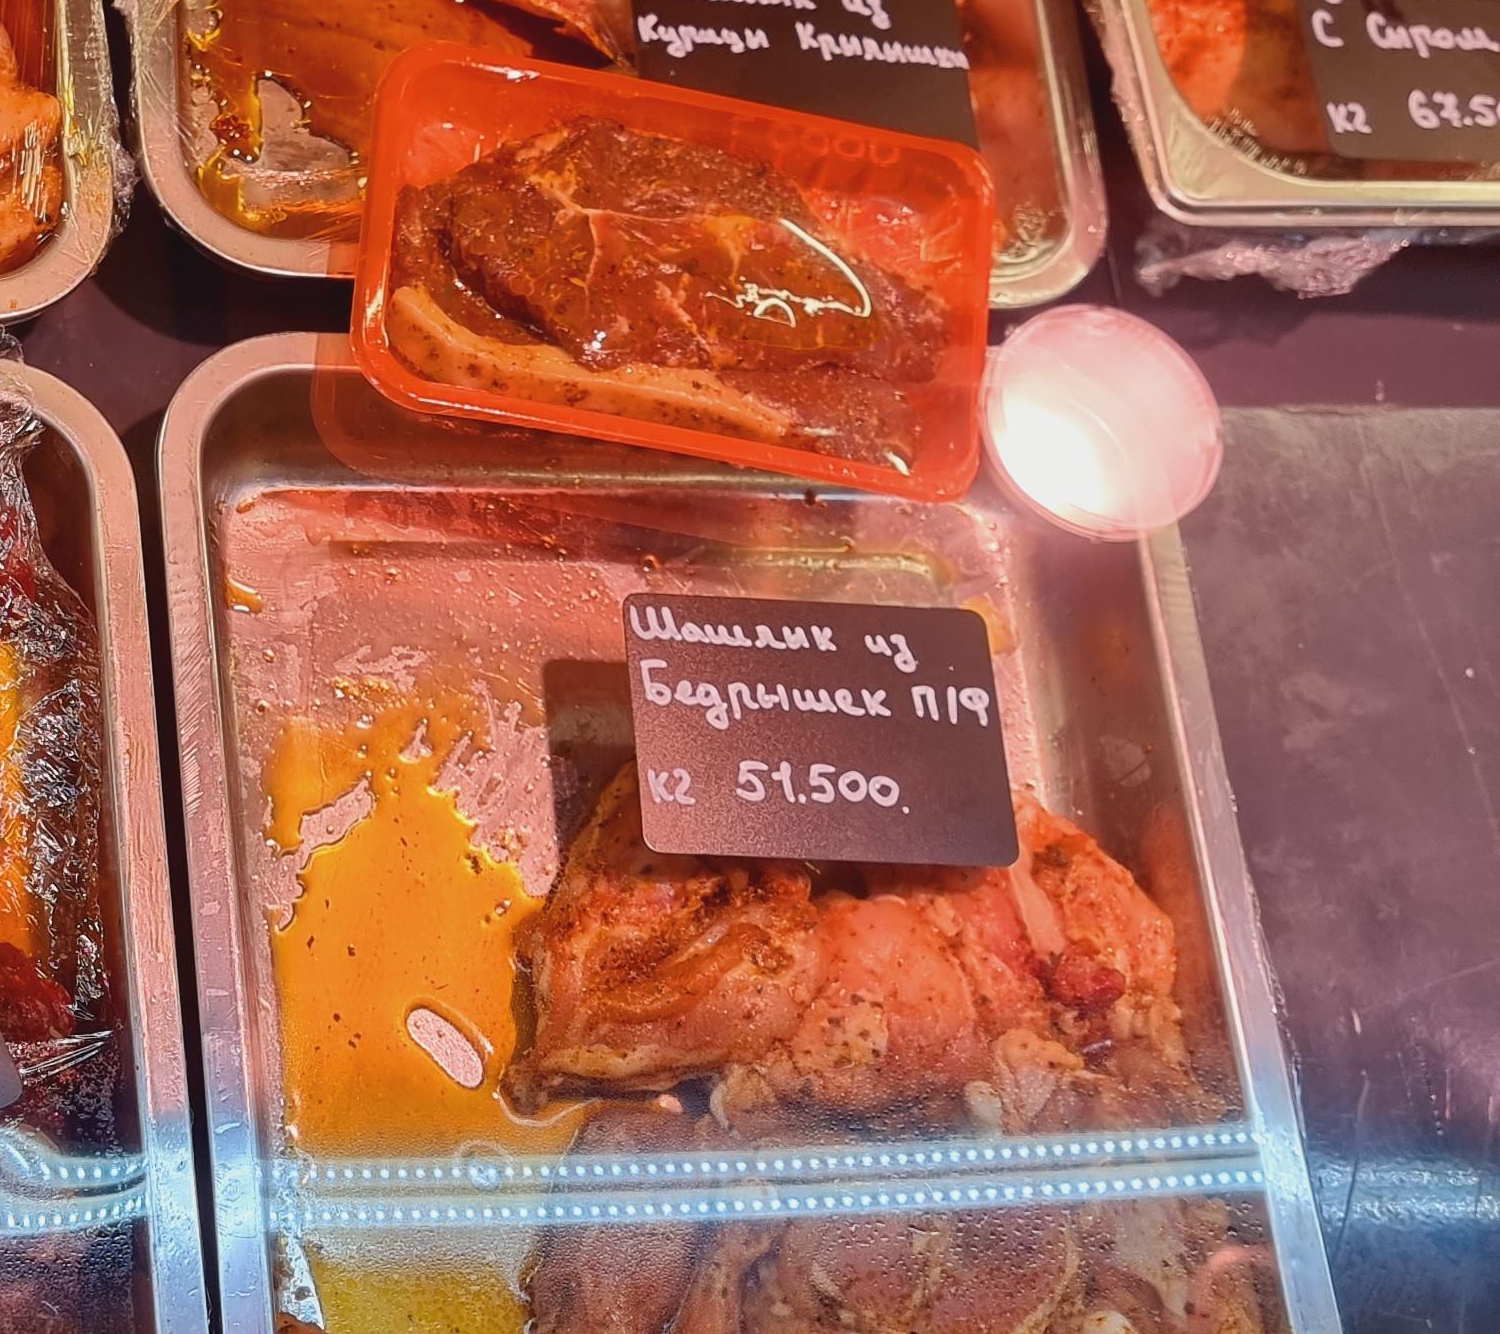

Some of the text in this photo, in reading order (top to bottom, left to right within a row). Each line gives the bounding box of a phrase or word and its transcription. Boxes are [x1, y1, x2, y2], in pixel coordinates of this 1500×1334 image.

[1408, 89, 1500, 129] 67.5
[629, 605, 919, 673] Шашлык из
[639, 659, 892, 730] Бедрышек
